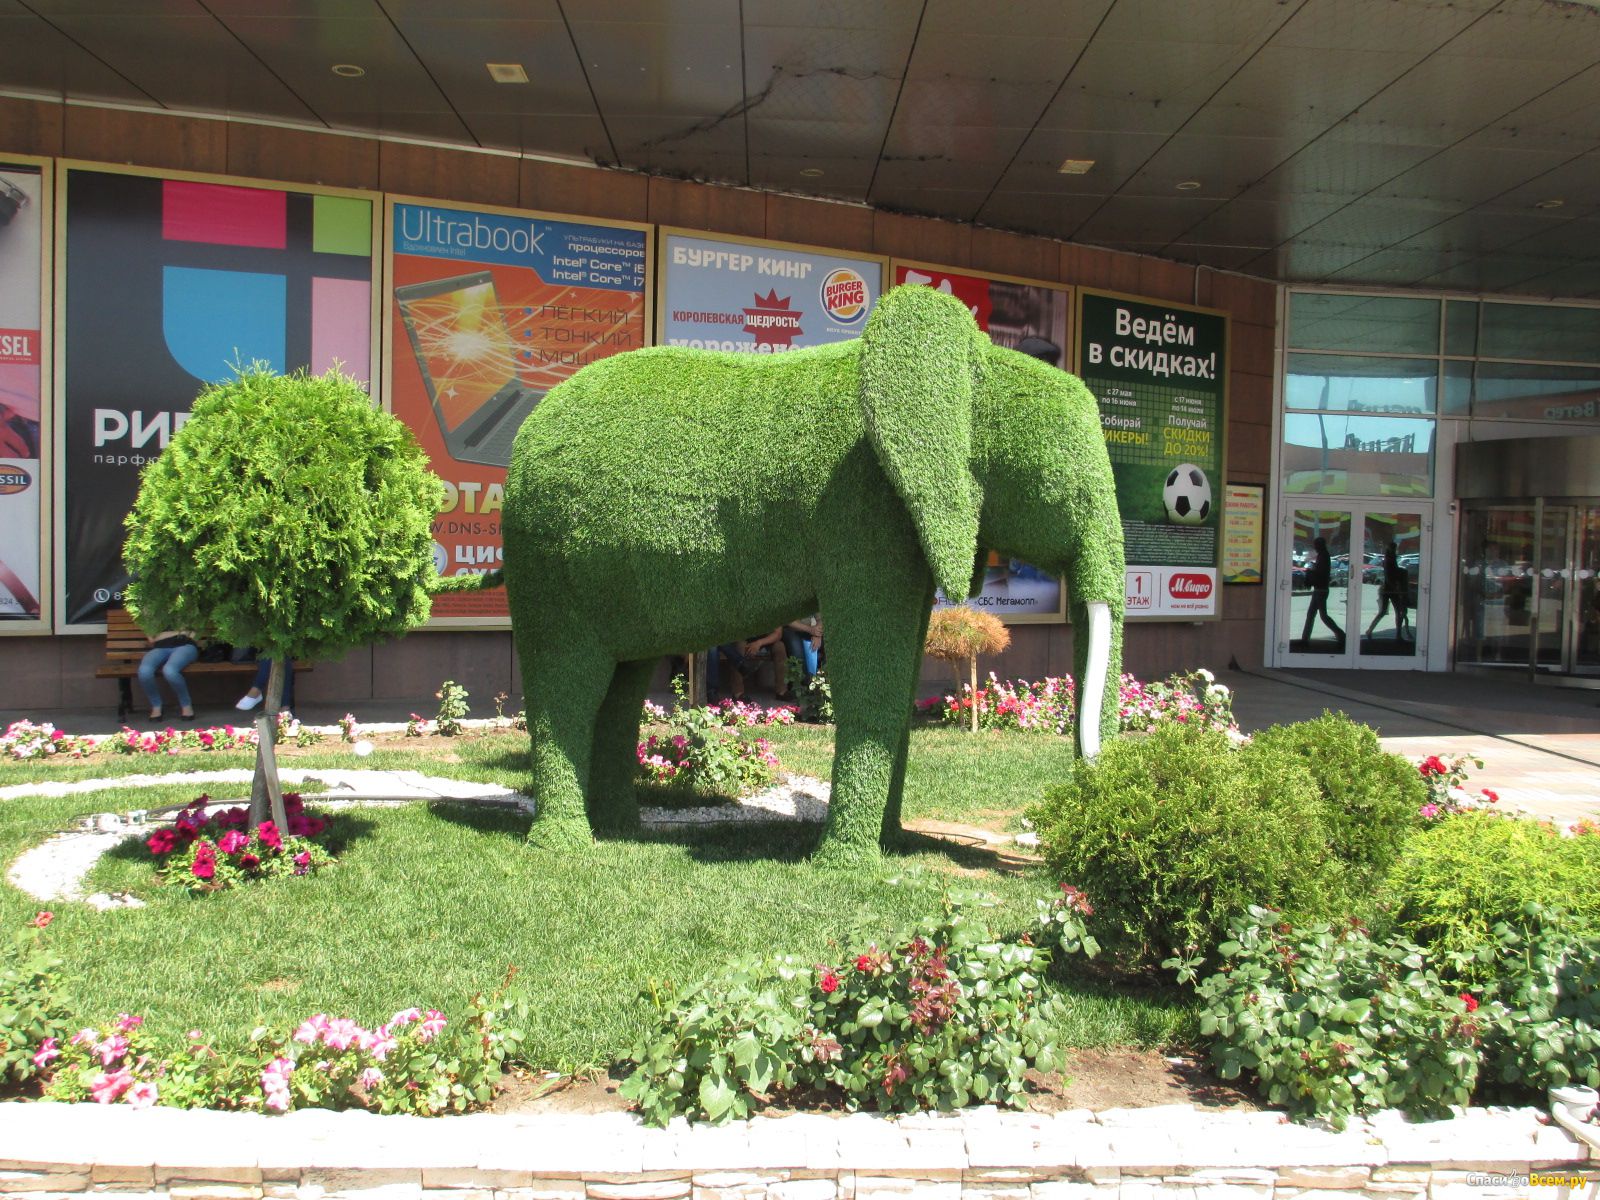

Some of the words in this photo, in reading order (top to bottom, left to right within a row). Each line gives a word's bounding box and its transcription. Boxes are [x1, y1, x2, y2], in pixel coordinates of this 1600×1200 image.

[672, 246, 754, 272] БУРГЕР
[757, 256, 812, 279] КИНГ
[634, 276, 645, 287] i7
[826, 280, 863, 297] BURGER
[827, 290, 865, 311] KING
[540, 303, 628, 325] ЛЁГКИЙ
[672, 310, 744, 325] КОРОЛЕВСКАЯ
[746, 314, 800, 329] ЩЕДРОСТЬ
[1116, 308, 1194, 345] Ведём
[0, 335, 32, 356] SEL
[540, 327, 632, 346] ТОНКИЙ
[1109, 345, 1216, 380] скидках!
[1119, 399, 1137, 407] июня
[1100, 414, 1141, 430] Собирай
[1168, 414, 1207, 430] Получай
[1104, 431, 1148, 444] ИКЕРЫ!
[1163, 427, 1210, 443] СКИДКИ
[1163, 441, 1182, 456] ДО
[1135, 575, 1142, 595] 1
[1126, 596, 1150, 606] ЭТАЖ
